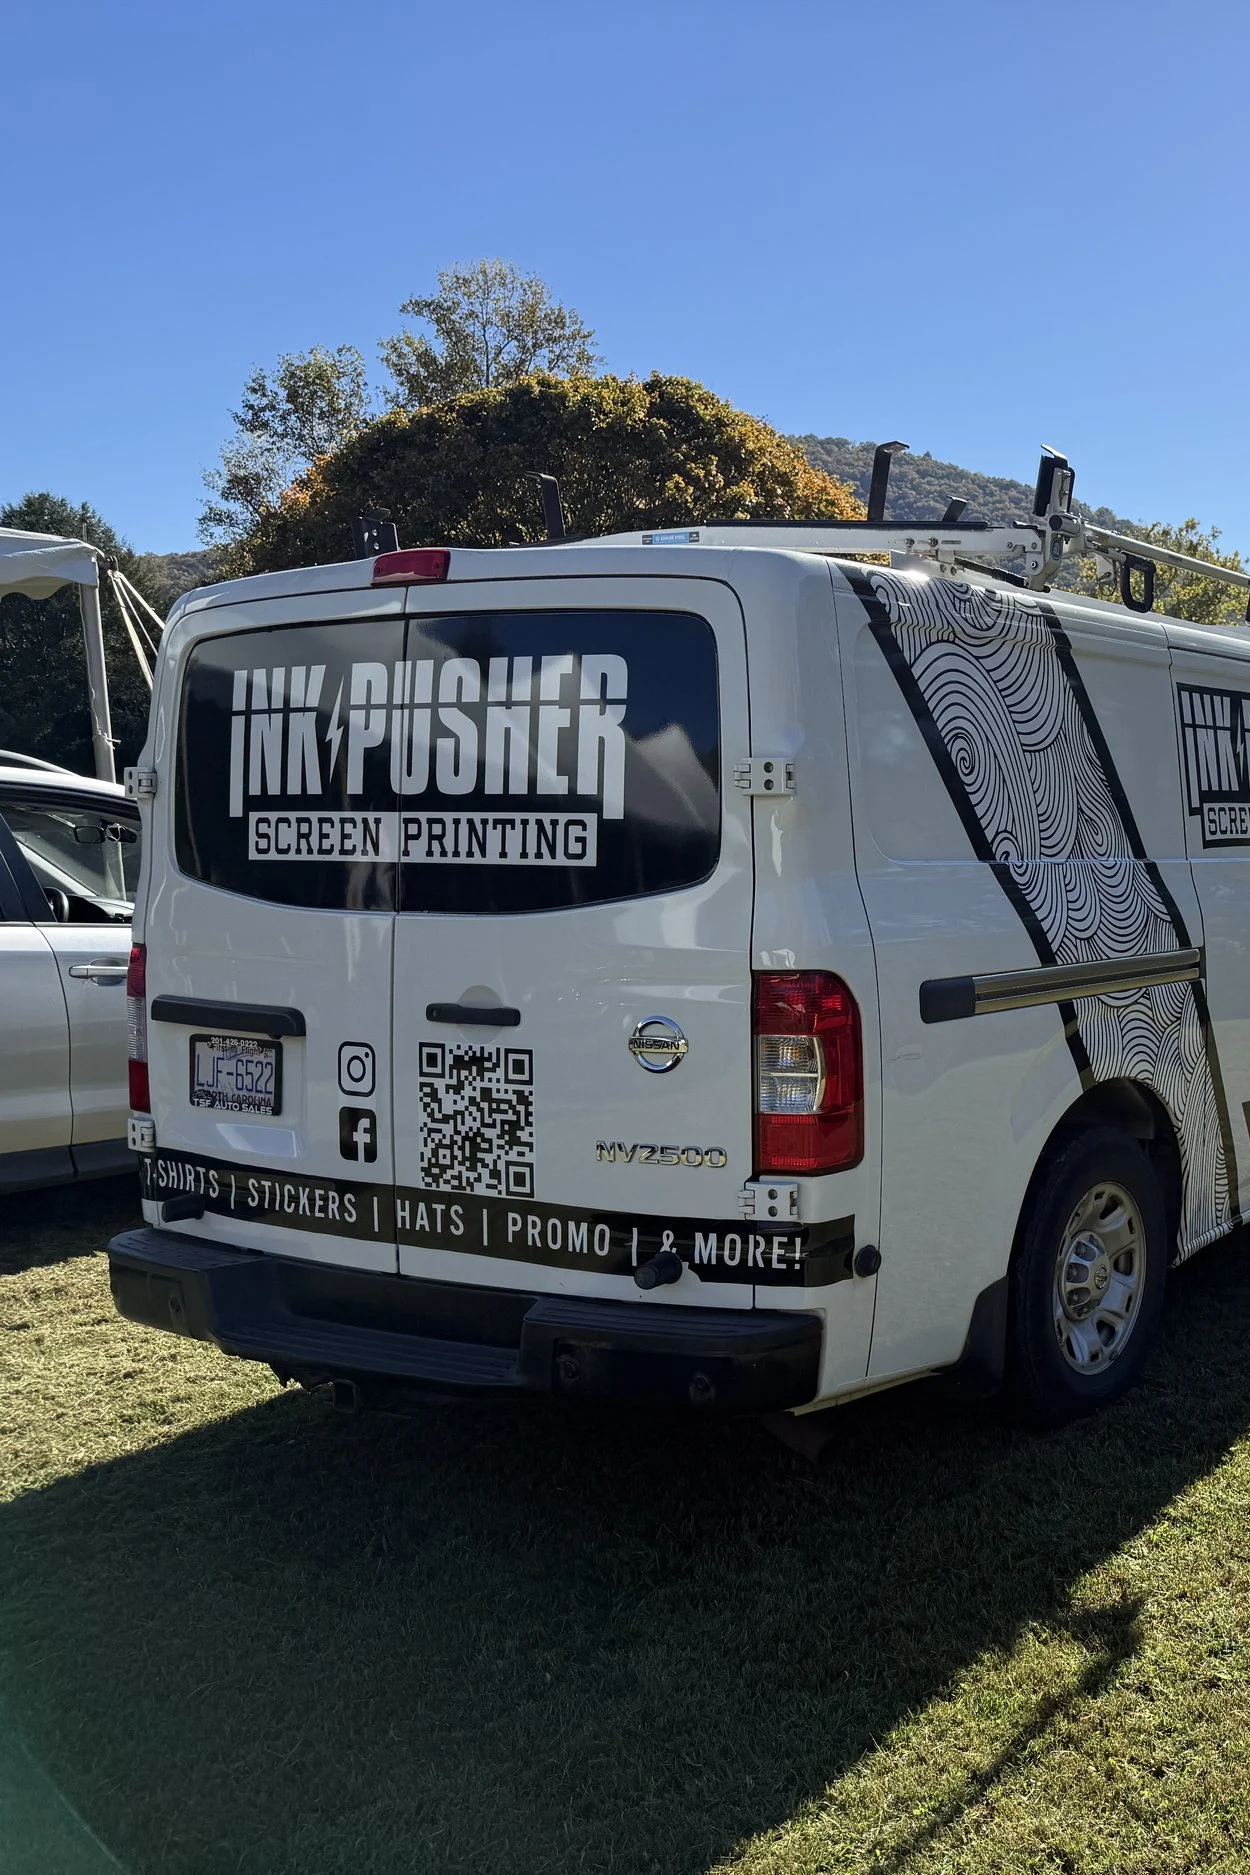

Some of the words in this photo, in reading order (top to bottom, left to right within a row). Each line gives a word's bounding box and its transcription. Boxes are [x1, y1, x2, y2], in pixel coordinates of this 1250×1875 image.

[229, 664, 327, 818] INK
[346, 653, 628, 820] PUSHER
[1180, 690, 1240, 808] INK
[255, 816, 382, 857] SCREEN
[402, 817, 588, 861] PRINTING
[633, 1037, 680, 1051] NISSAN
[196, 1053, 273, 1095] LJF-6522
[192, 1098, 211, 1108] TSF
[214, 1101, 240, 1111] AUTO
[241, 1104, 273, 1115] SALES
[595, 1140, 728, 1169] NV2500
[144, 1157, 219, 1199] T-SHIRTS
[247, 1178, 357, 1224] STICKERS
[396, 1198, 465, 1236] HATS
[507, 1211, 611, 1257] PROMO
[694, 1231, 802, 1270] MORE!
